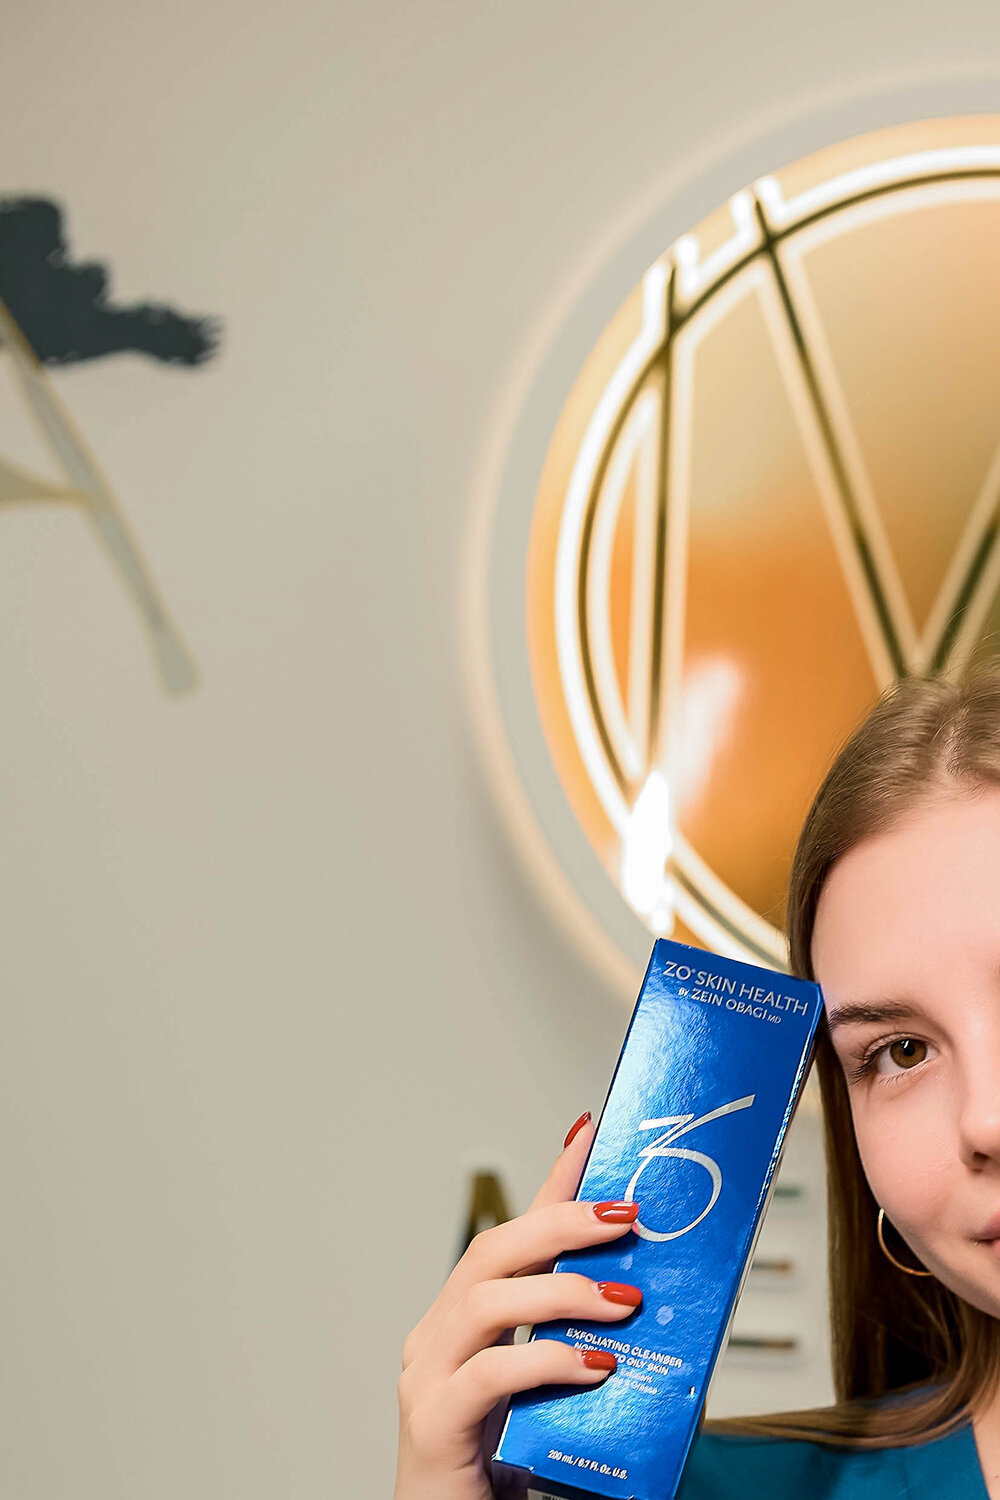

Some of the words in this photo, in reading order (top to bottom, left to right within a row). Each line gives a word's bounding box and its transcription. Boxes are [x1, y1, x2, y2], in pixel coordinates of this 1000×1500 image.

[678, 987, 690, 997] BY
[691, 988, 723, 1006] ZEIN
[725, 999, 768, 1020] OBAGI
[767, 1014, 782, 1024] MD
[695, 970, 737, 995] SKIN
[739, 983, 809, 1017] HEALTH
[566, 1327, 630, 1354] EXFOLIATING
[631, 1346, 683, 1368] CLEANSER
[626, 1356, 647, 1369] OILY
[646, 1362, 669, 1376] SKIN
[547, 1449, 563, 1461] 200
